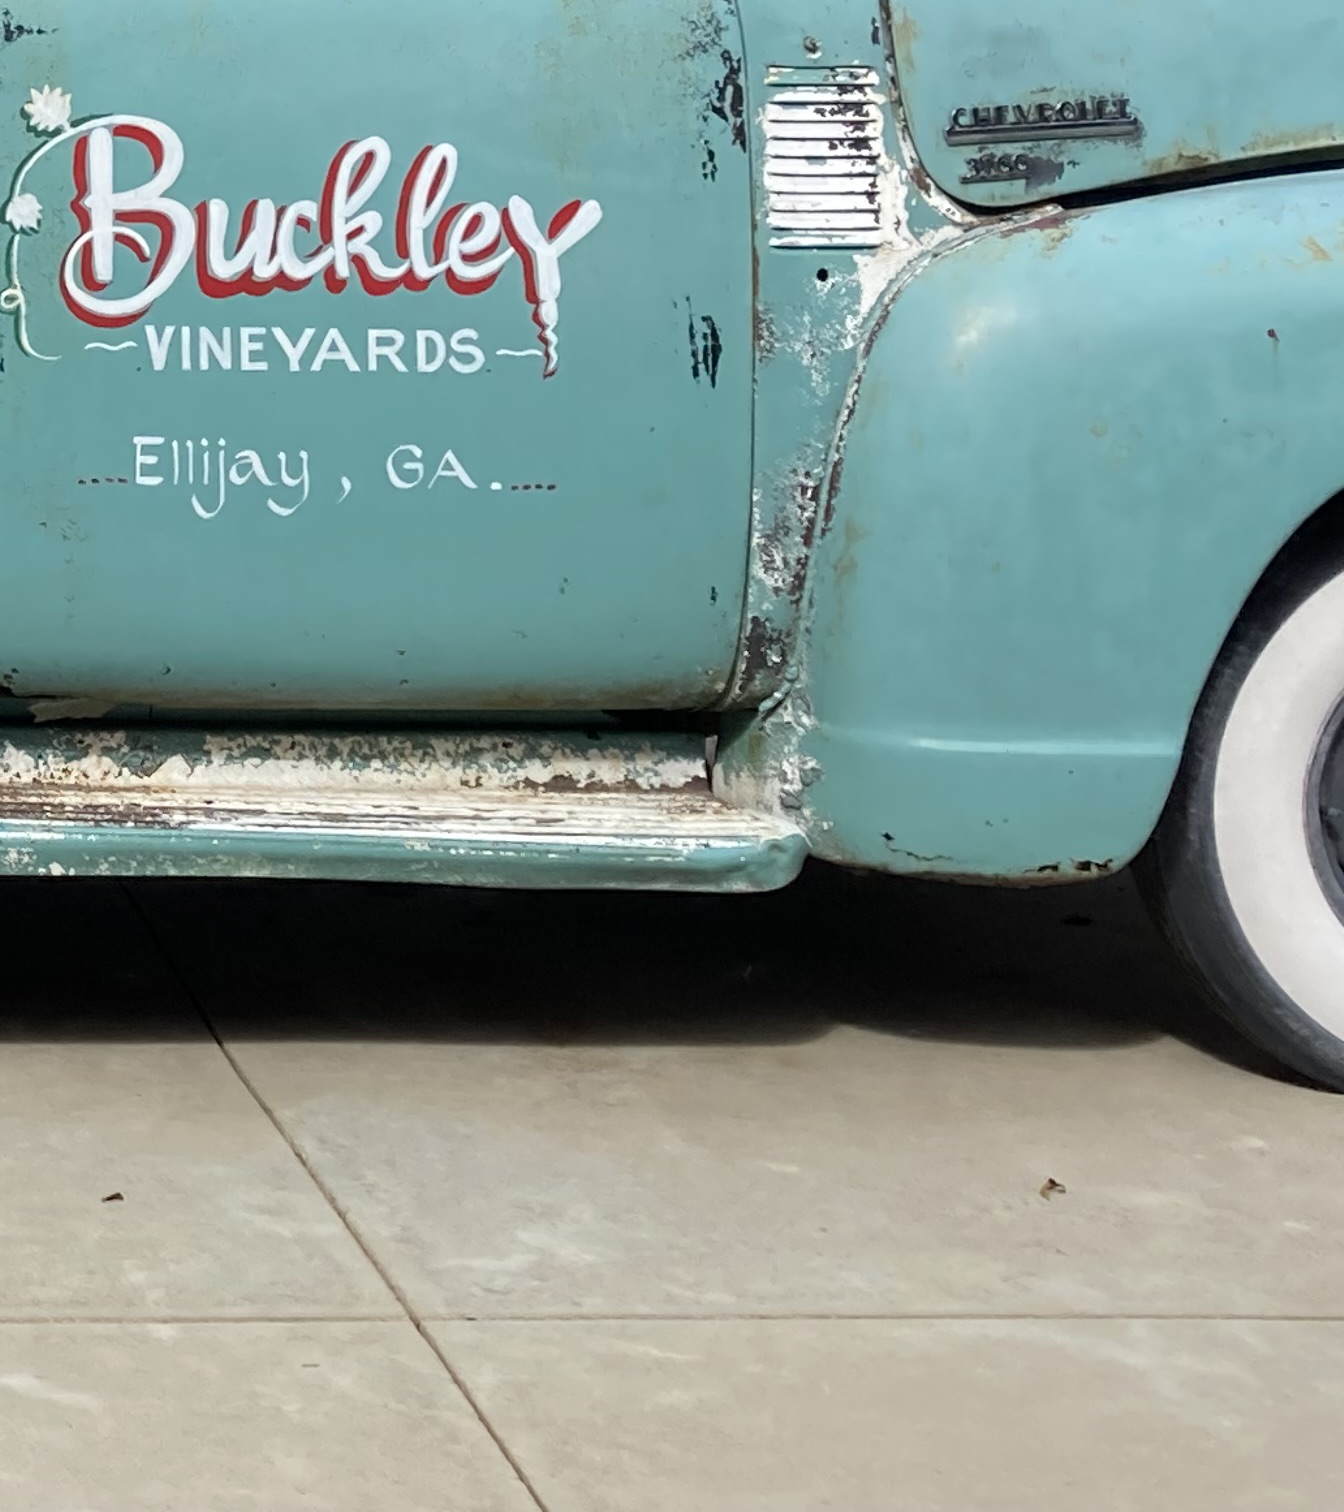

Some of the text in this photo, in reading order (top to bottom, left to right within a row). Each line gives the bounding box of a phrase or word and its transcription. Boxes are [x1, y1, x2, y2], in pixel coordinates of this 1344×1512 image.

[951, 97, 1131, 128] CHEVROLET
[59, 114, 603, 380] Buckley
[143, 325, 486, 374] VINEYARDS
